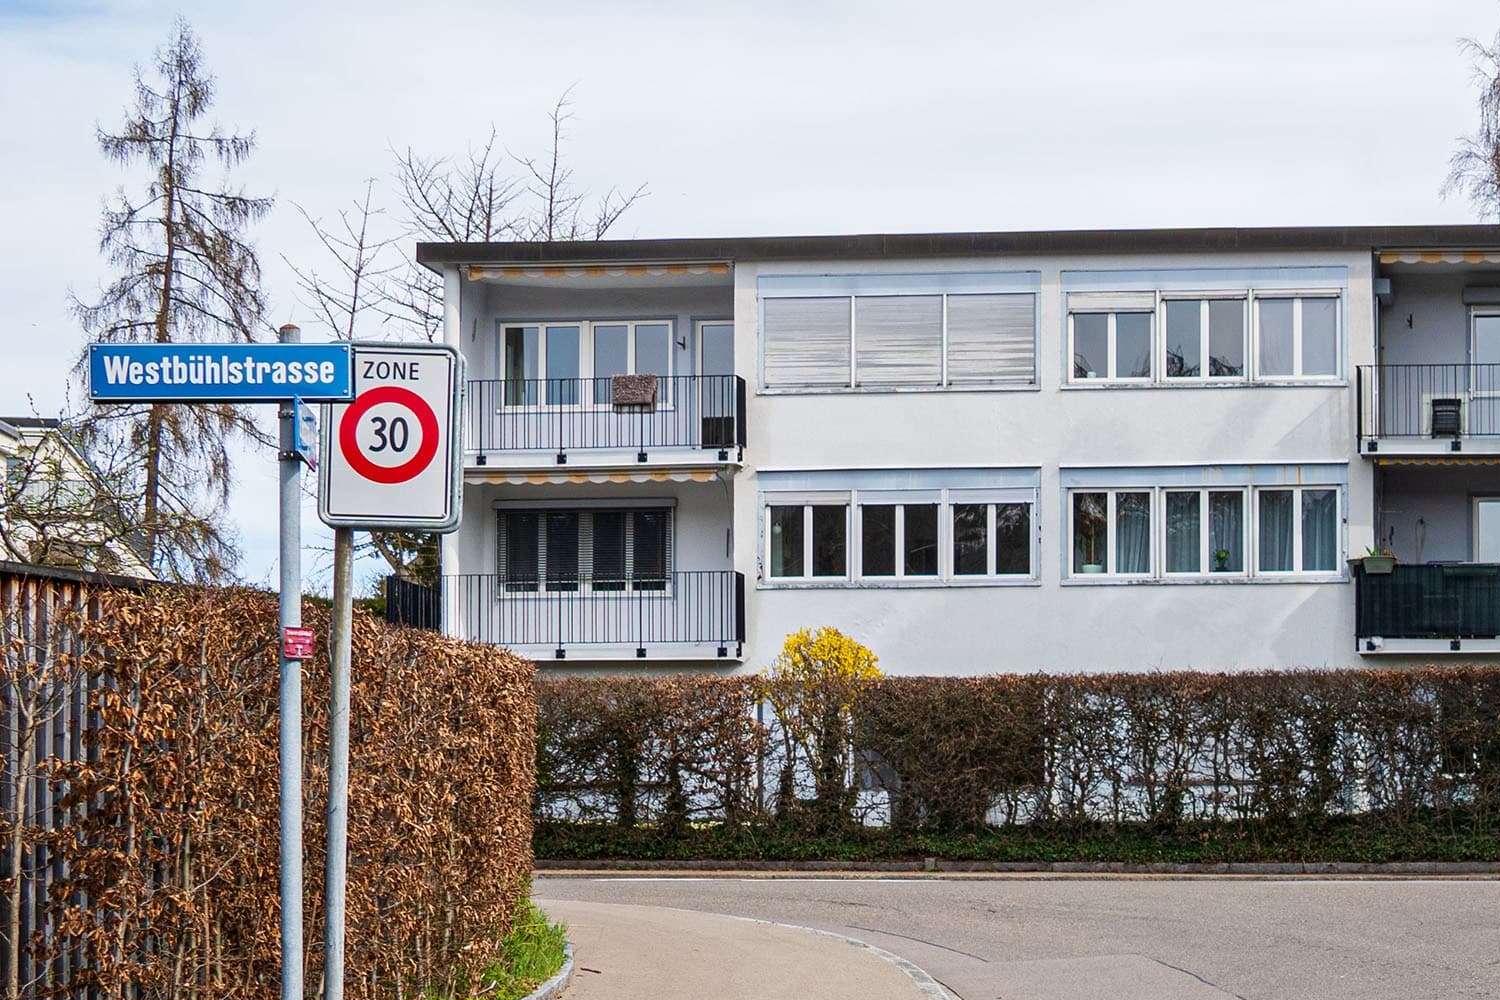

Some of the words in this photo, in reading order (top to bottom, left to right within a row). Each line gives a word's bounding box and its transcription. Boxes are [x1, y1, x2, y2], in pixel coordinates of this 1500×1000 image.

[104, 355, 334, 384] Westbühlstrasse
[363, 361, 419, 380] ZONE
[369, 416, 409, 452] 30
